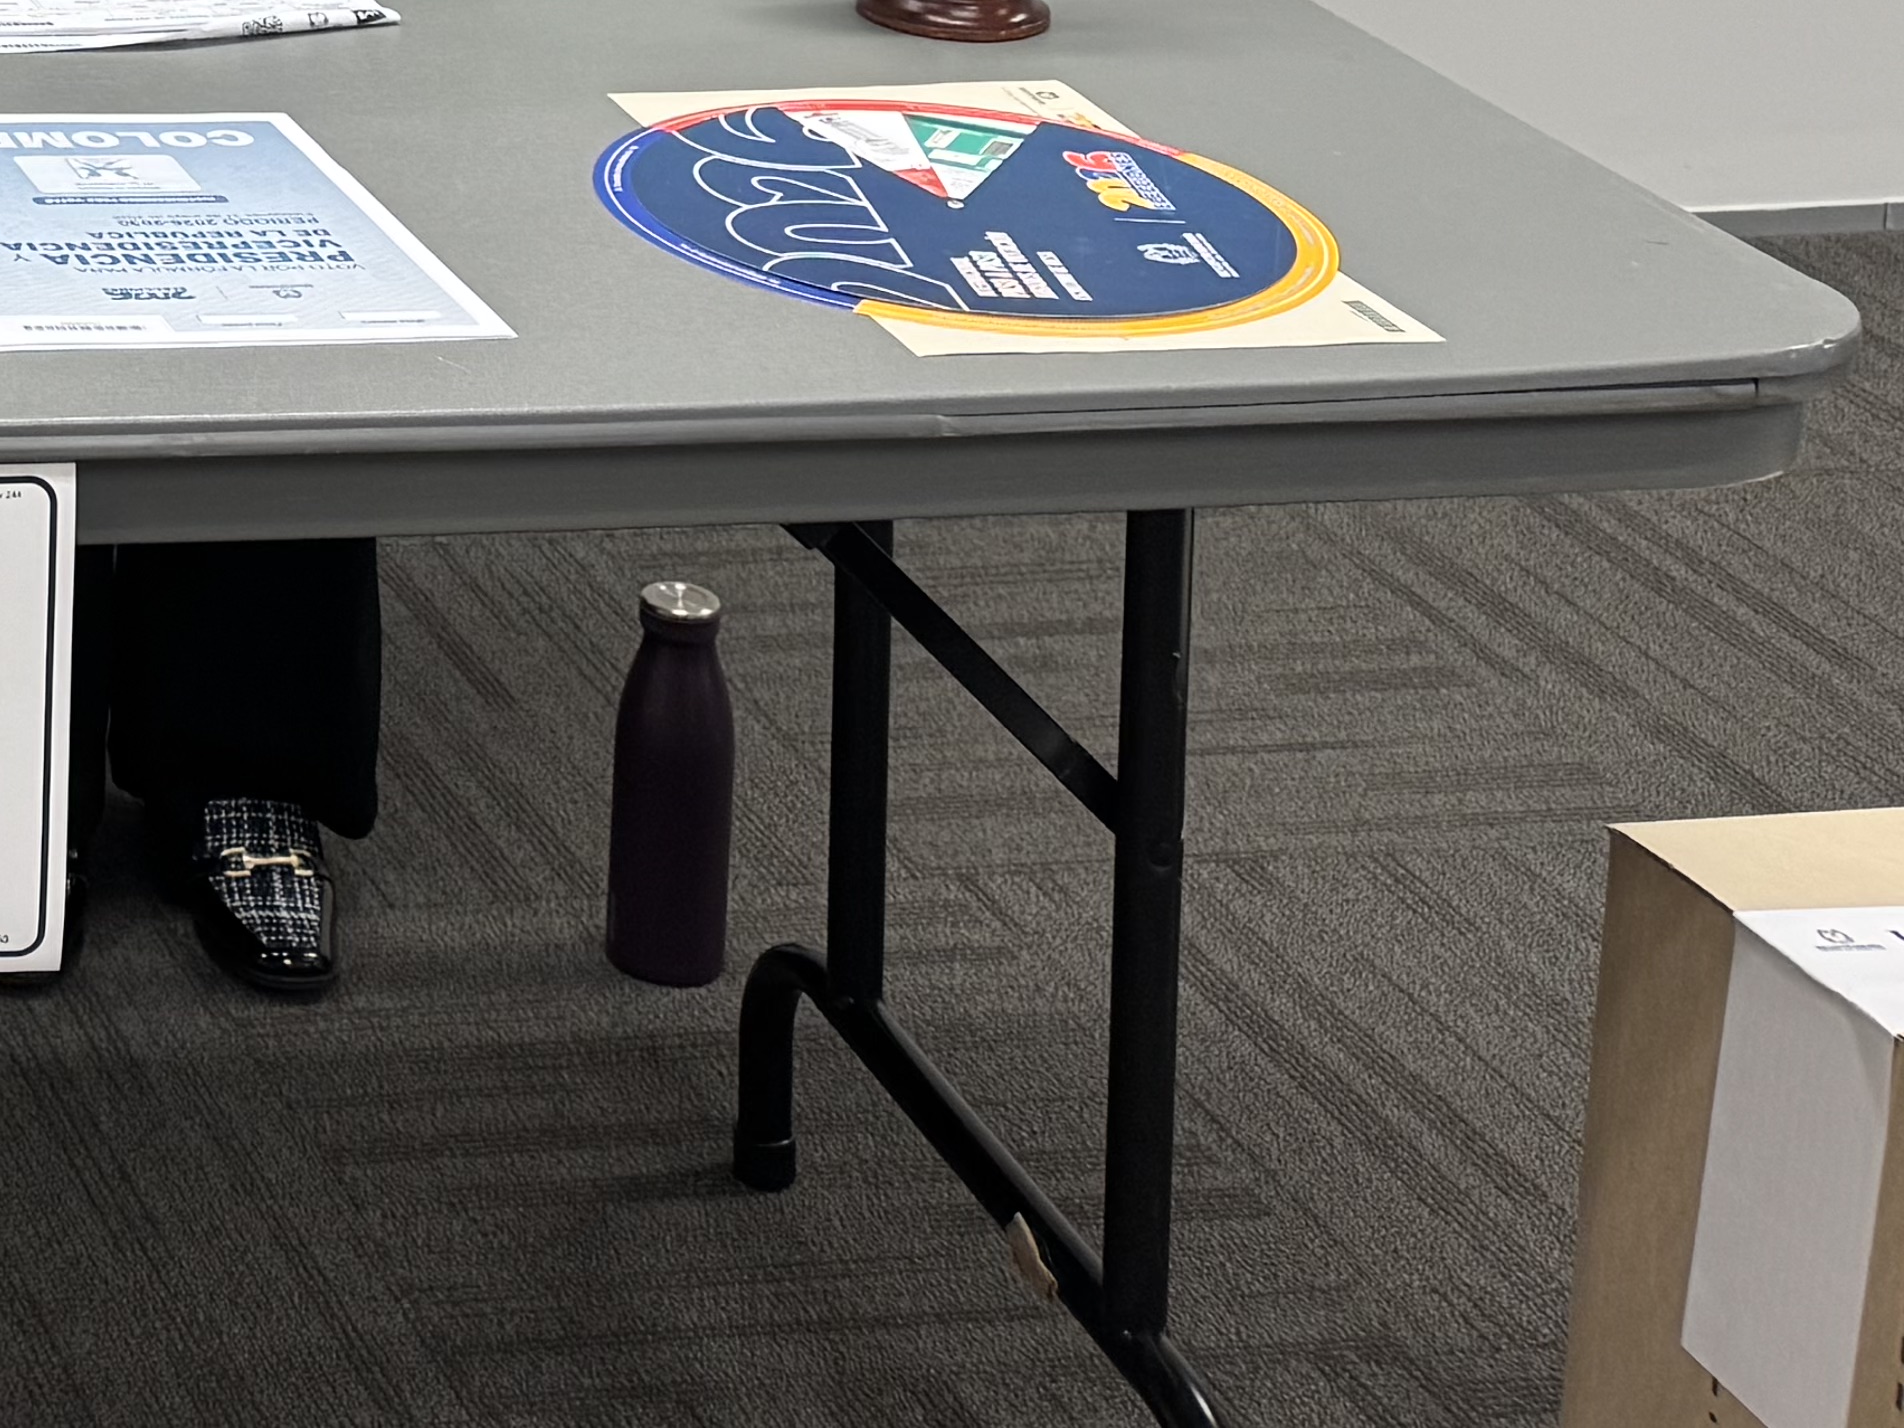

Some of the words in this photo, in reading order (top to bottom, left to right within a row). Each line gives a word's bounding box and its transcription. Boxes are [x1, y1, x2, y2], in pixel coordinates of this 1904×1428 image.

[248, 229, 288, 237] LA
[291, 228, 333, 236] DE
[7, 252, 31, 262] Y
[38, 250, 357, 265] PRESIDENCIA
